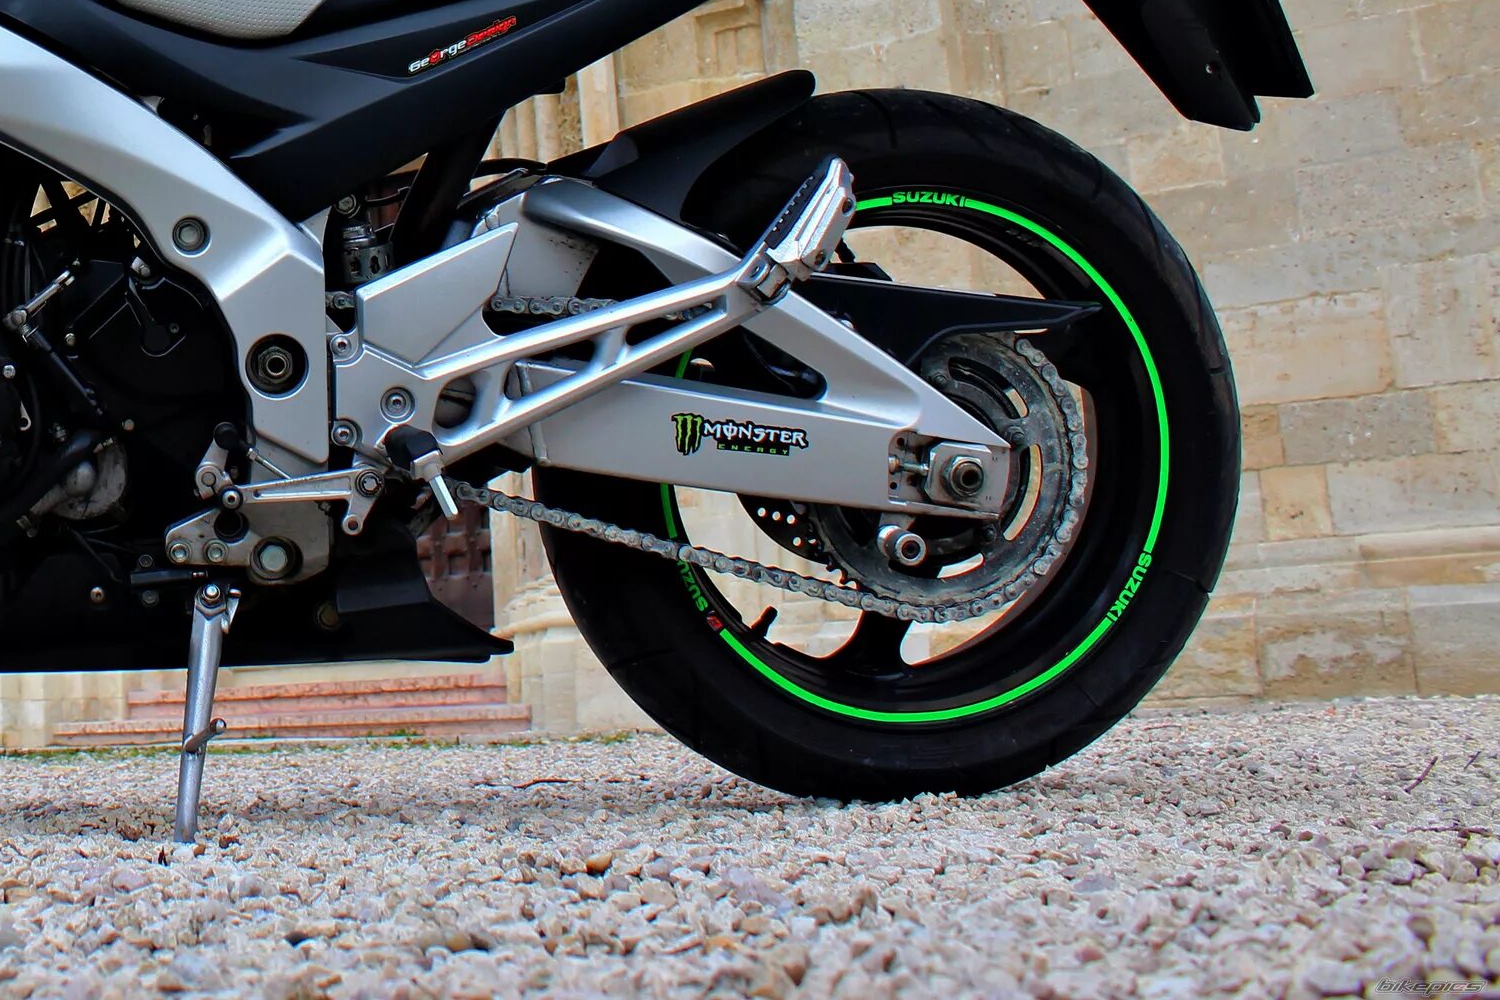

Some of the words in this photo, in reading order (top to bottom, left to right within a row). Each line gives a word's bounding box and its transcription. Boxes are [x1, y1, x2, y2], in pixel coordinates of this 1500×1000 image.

[892, 191, 966, 207] SUZUKI
[717, 443, 789, 455] ENERGY
[1106, 553, 1152, 622] SUZUKI
